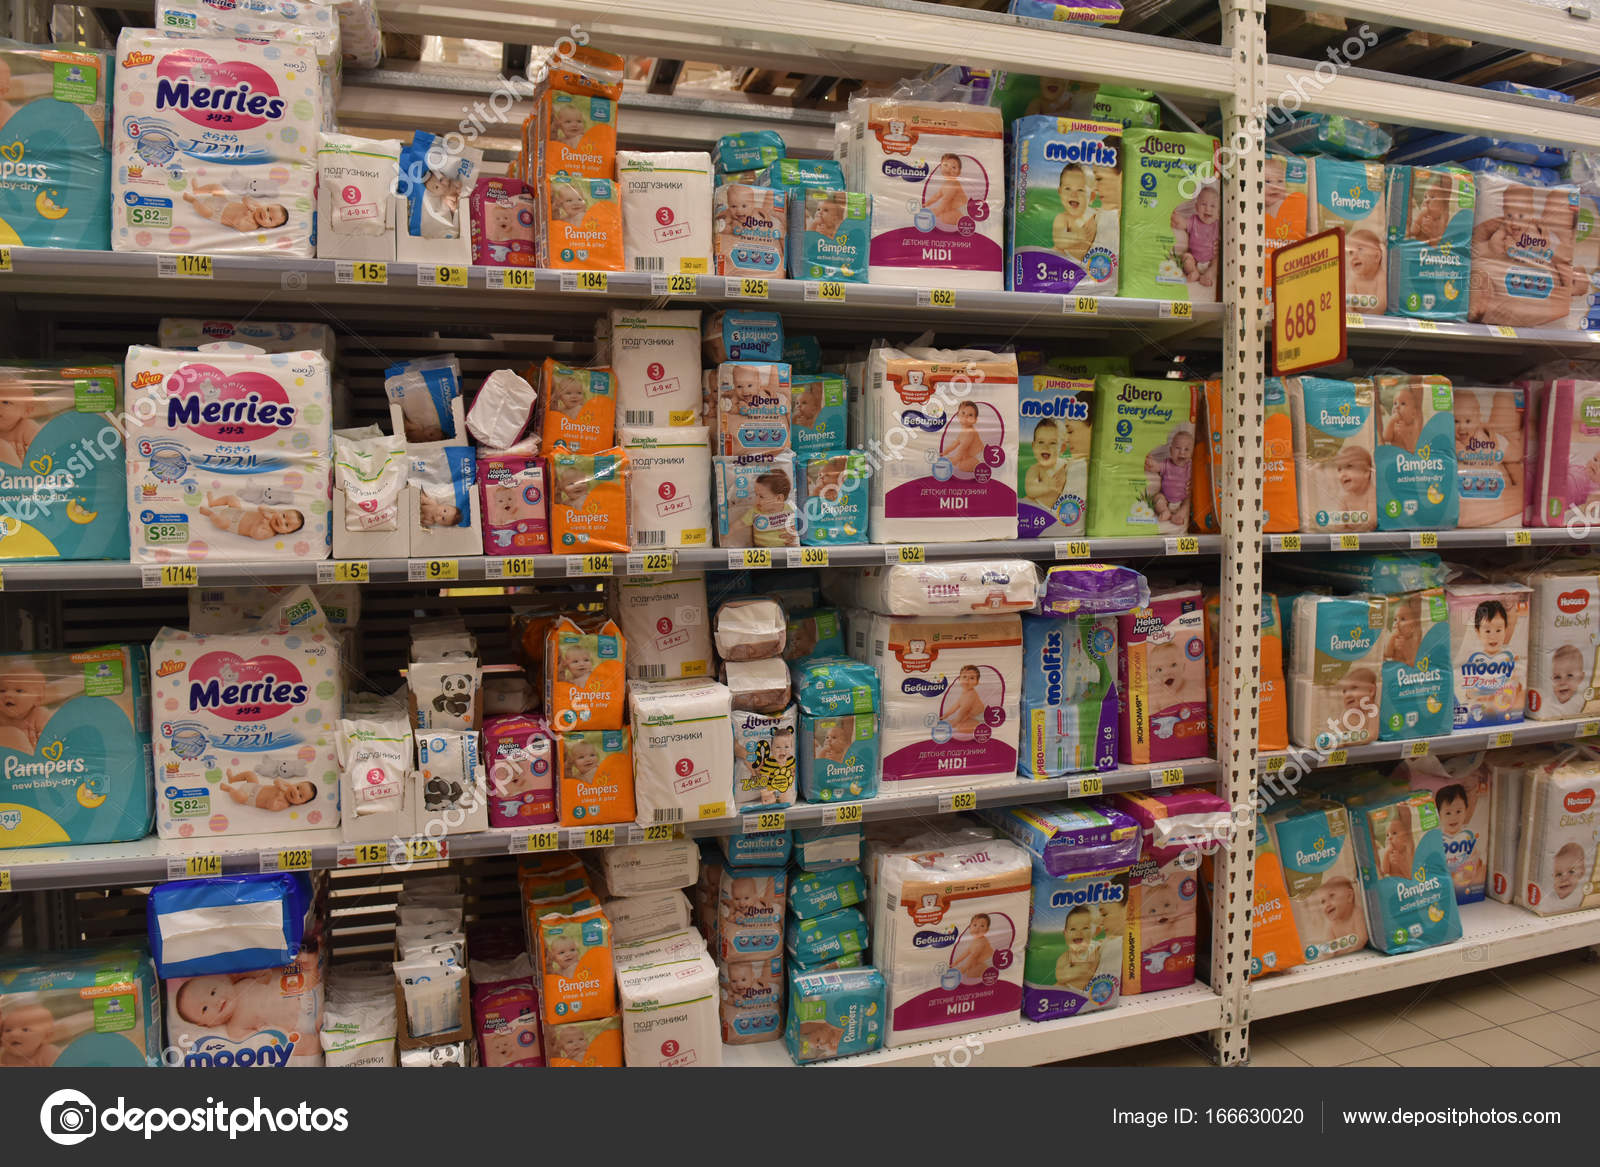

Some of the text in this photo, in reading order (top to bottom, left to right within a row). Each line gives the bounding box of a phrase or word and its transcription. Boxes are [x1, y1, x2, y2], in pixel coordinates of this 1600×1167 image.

[1067, 11, 1096, 23] JUMBO
[125, 52, 153, 67] New
[156, 79, 285, 120] Merries
[1071, 122, 1097, 132] JUMBO
[201, 132, 239, 143] さらさら
[1140, 136, 1185, 155] Libero
[561, 147, 603, 164] Pampers
[1046, 141, 1115, 165] molfix
[885, 165, 926, 178] Бебилон
[1141, 157, 1197, 174] Everyday
[324, 167, 379, 179] ПОДГУЗНИКИ
[629, 181, 682, 190] ПОДГУЗНИКИ
[1331, 192, 1371, 209] Pampers
[743, 216, 773, 228] Libero
[565, 225, 607, 241] Pampers
[817, 239, 856, 255] Pampers
[1516, 234, 1547, 248] Libero
[922, 248, 951, 261] MIDI
[1283, 248, 1329, 272] СКИДКИ!
[1419, 248, 1461, 266] Pampers
[181, 256, 208, 272] 1714
[358, 264, 378, 279] 15
[508, 270, 528, 285] 161
[1062, 269, 1075, 280] 68
[582, 273, 602, 287] 184
[671, 277, 691, 291] 225
[744, 280, 764, 294] 325
[822, 283, 841, 297] 330
[934, 291, 950, 303] 652
[1079, 297, 1094, 310] 670
[1174, 303, 1188, 315] 829
[1285, 299, 1317, 341] 688
[1320, 291, 1332, 312] 82
[622, 338, 674, 347] ПОДГУЗНИКИ
[135, 371, 163, 386] New
[1046, 380, 1071, 389] JUMBO
[1117, 384, 1162, 402] Libero
[748, 395, 779, 406] Libero
[168, 396, 296, 428] Merries
[1022, 399, 1087, 418] molfix
[1117, 404, 1173, 421] Everyday
[904, 416, 944, 426] Бебилон
[1321, 411, 1361, 426] Pampers
[561, 417, 600, 434] Pampers
[799, 430, 835, 443] Pampers
[215, 445, 250, 453] さらさら
[1468, 438, 1495, 451] Libero
[633, 457, 685, 467] ПОДГУЗНИКИ
[1397, 455, 1444, 473] Pampers
[921, 488, 988, 496] ДЕТСКИЕ ПОДГУЗНИКИ
[820, 502, 859, 515] Pampers
[940, 497, 968, 509] MIDI
[566, 510, 609, 523] Pampers
[1034, 517, 1046, 527] 68
[1071, 543, 1086, 554] 670
[1180, 539, 1194, 550] 829
[1283, 536, 1297, 548] 688
[747, 551, 765, 563] 325
[805, 549, 823, 561] 330
[902, 548, 919, 560] 652
[506, 559, 526, 573] 161
[588, 557, 608, 570] 184
[647, 556, 667, 568] 225
[166, 567, 192, 581] 1714
[342, 563, 359, 577] 15
[1136, 616, 1161, 626] Helen
[1133, 624, 1163, 635] Harper
[1152, 630, 1171, 641] Baby
[1331, 636, 1370, 651] Pampers
[160, 661, 186, 674] New
[1043, 632, 1062, 705] molfix
[1462, 661, 1515, 677] moony
[1397, 669, 1440, 686] Pampers
[903, 681, 945, 693] Бебилон
[190, 677, 307, 711] Merries
[569, 687, 611, 701] Pampers
[742, 715, 780, 729] Libero
[1196, 722, 1206, 731] 70
[648, 732, 702, 744] ПОДГУЗНИКИ
[1104, 726, 1112, 740] 68
[5, 756, 85, 779] Pampers
[827, 763, 864, 775] Pampers
[938, 758, 967, 770] MIDI
[1164, 770, 1179, 782] 750
[12, 777, 78, 791] new baby-dry
[577, 784, 618, 797] Pampers
[1083, 780, 1099, 792] 670
[955, 795, 971, 807] 652
[4, 814, 17, 824] 94
[840, 807, 857, 819] 330
[761, 815, 779, 828] 325
[590, 829, 609, 842] 184
[647, 827, 668, 839] 225
[532, 833, 551, 847] 161
[736, 838, 774, 848] Comfort
[1048, 836, 1075, 846] molfix
[283, 851, 307, 866] 1223
[360, 845, 378, 861] 15
[1296, 847, 1336, 866] Pampers
[191, 857, 216, 872] 1714
[1132, 861, 1157, 870] Helen
[1129, 868, 1160, 879] Harper
[1053, 883, 1122, 906] molfix
[1397, 876, 1440, 901] Pampers
[744, 905, 774, 917] Libero
[916, 932, 955, 946] Бебилон
[558, 977, 600, 992] Pampers
[743, 987, 773, 999] Libero
[947, 1001, 975, 1015] MIDI
[1064, 998, 1077, 1009] 68
[633, 1014, 688, 1029] ПОДГУЗНИКИ
[844, 1004, 857, 1043] Pampers
[185, 1043, 294, 1067] moony
